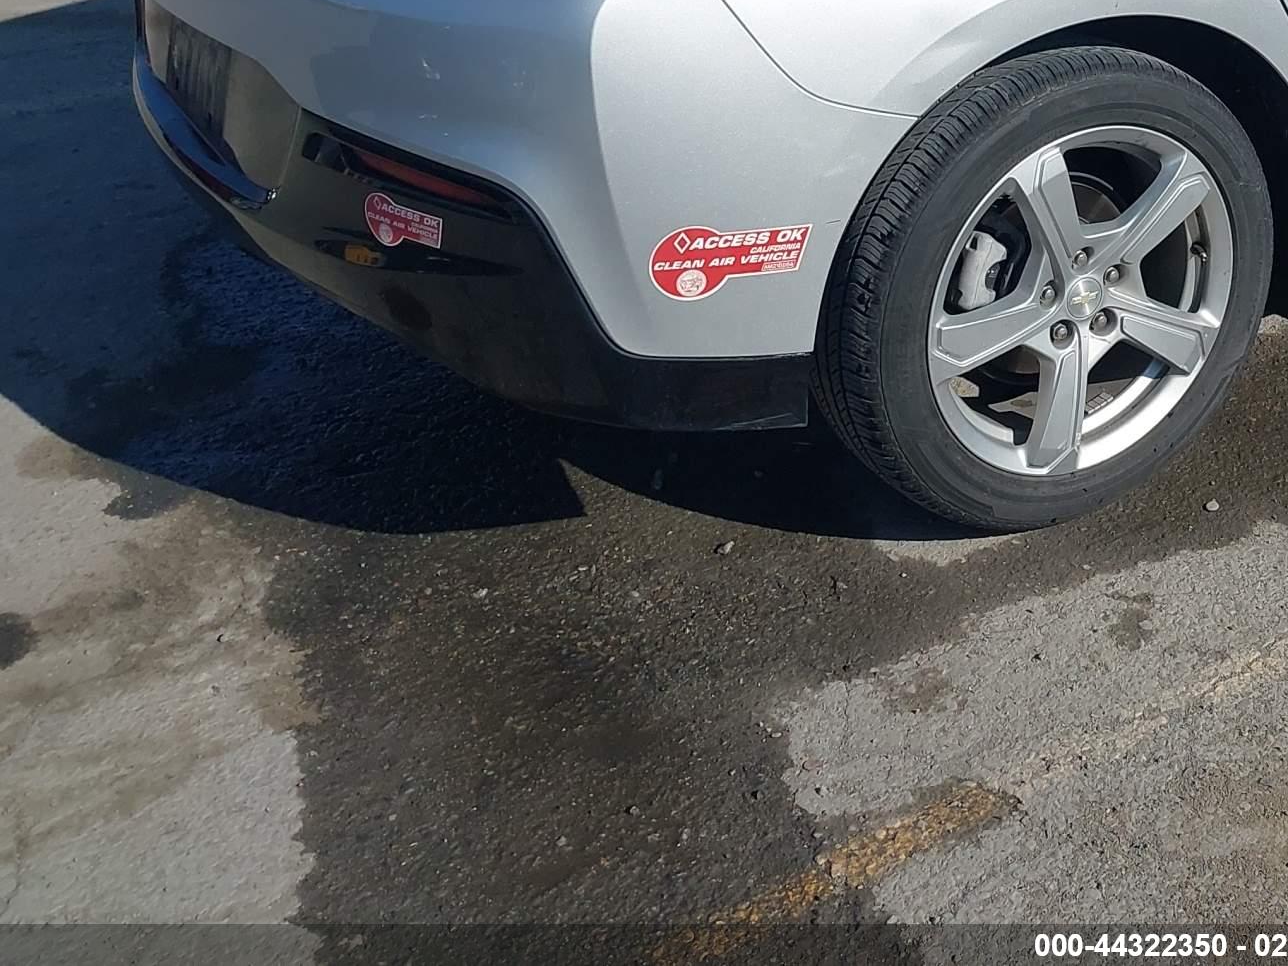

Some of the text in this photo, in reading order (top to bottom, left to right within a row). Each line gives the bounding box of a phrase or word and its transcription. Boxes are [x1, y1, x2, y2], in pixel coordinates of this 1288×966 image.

[382, 203, 421, 223] ACCESS
[423, 216, 439, 228] OK
[689, 228, 806, 251] ACCESS OK
[750, 242, 801, 254] CALIFORNIA
[653, 250, 801, 272] CLEAN AIR VEHICLE
